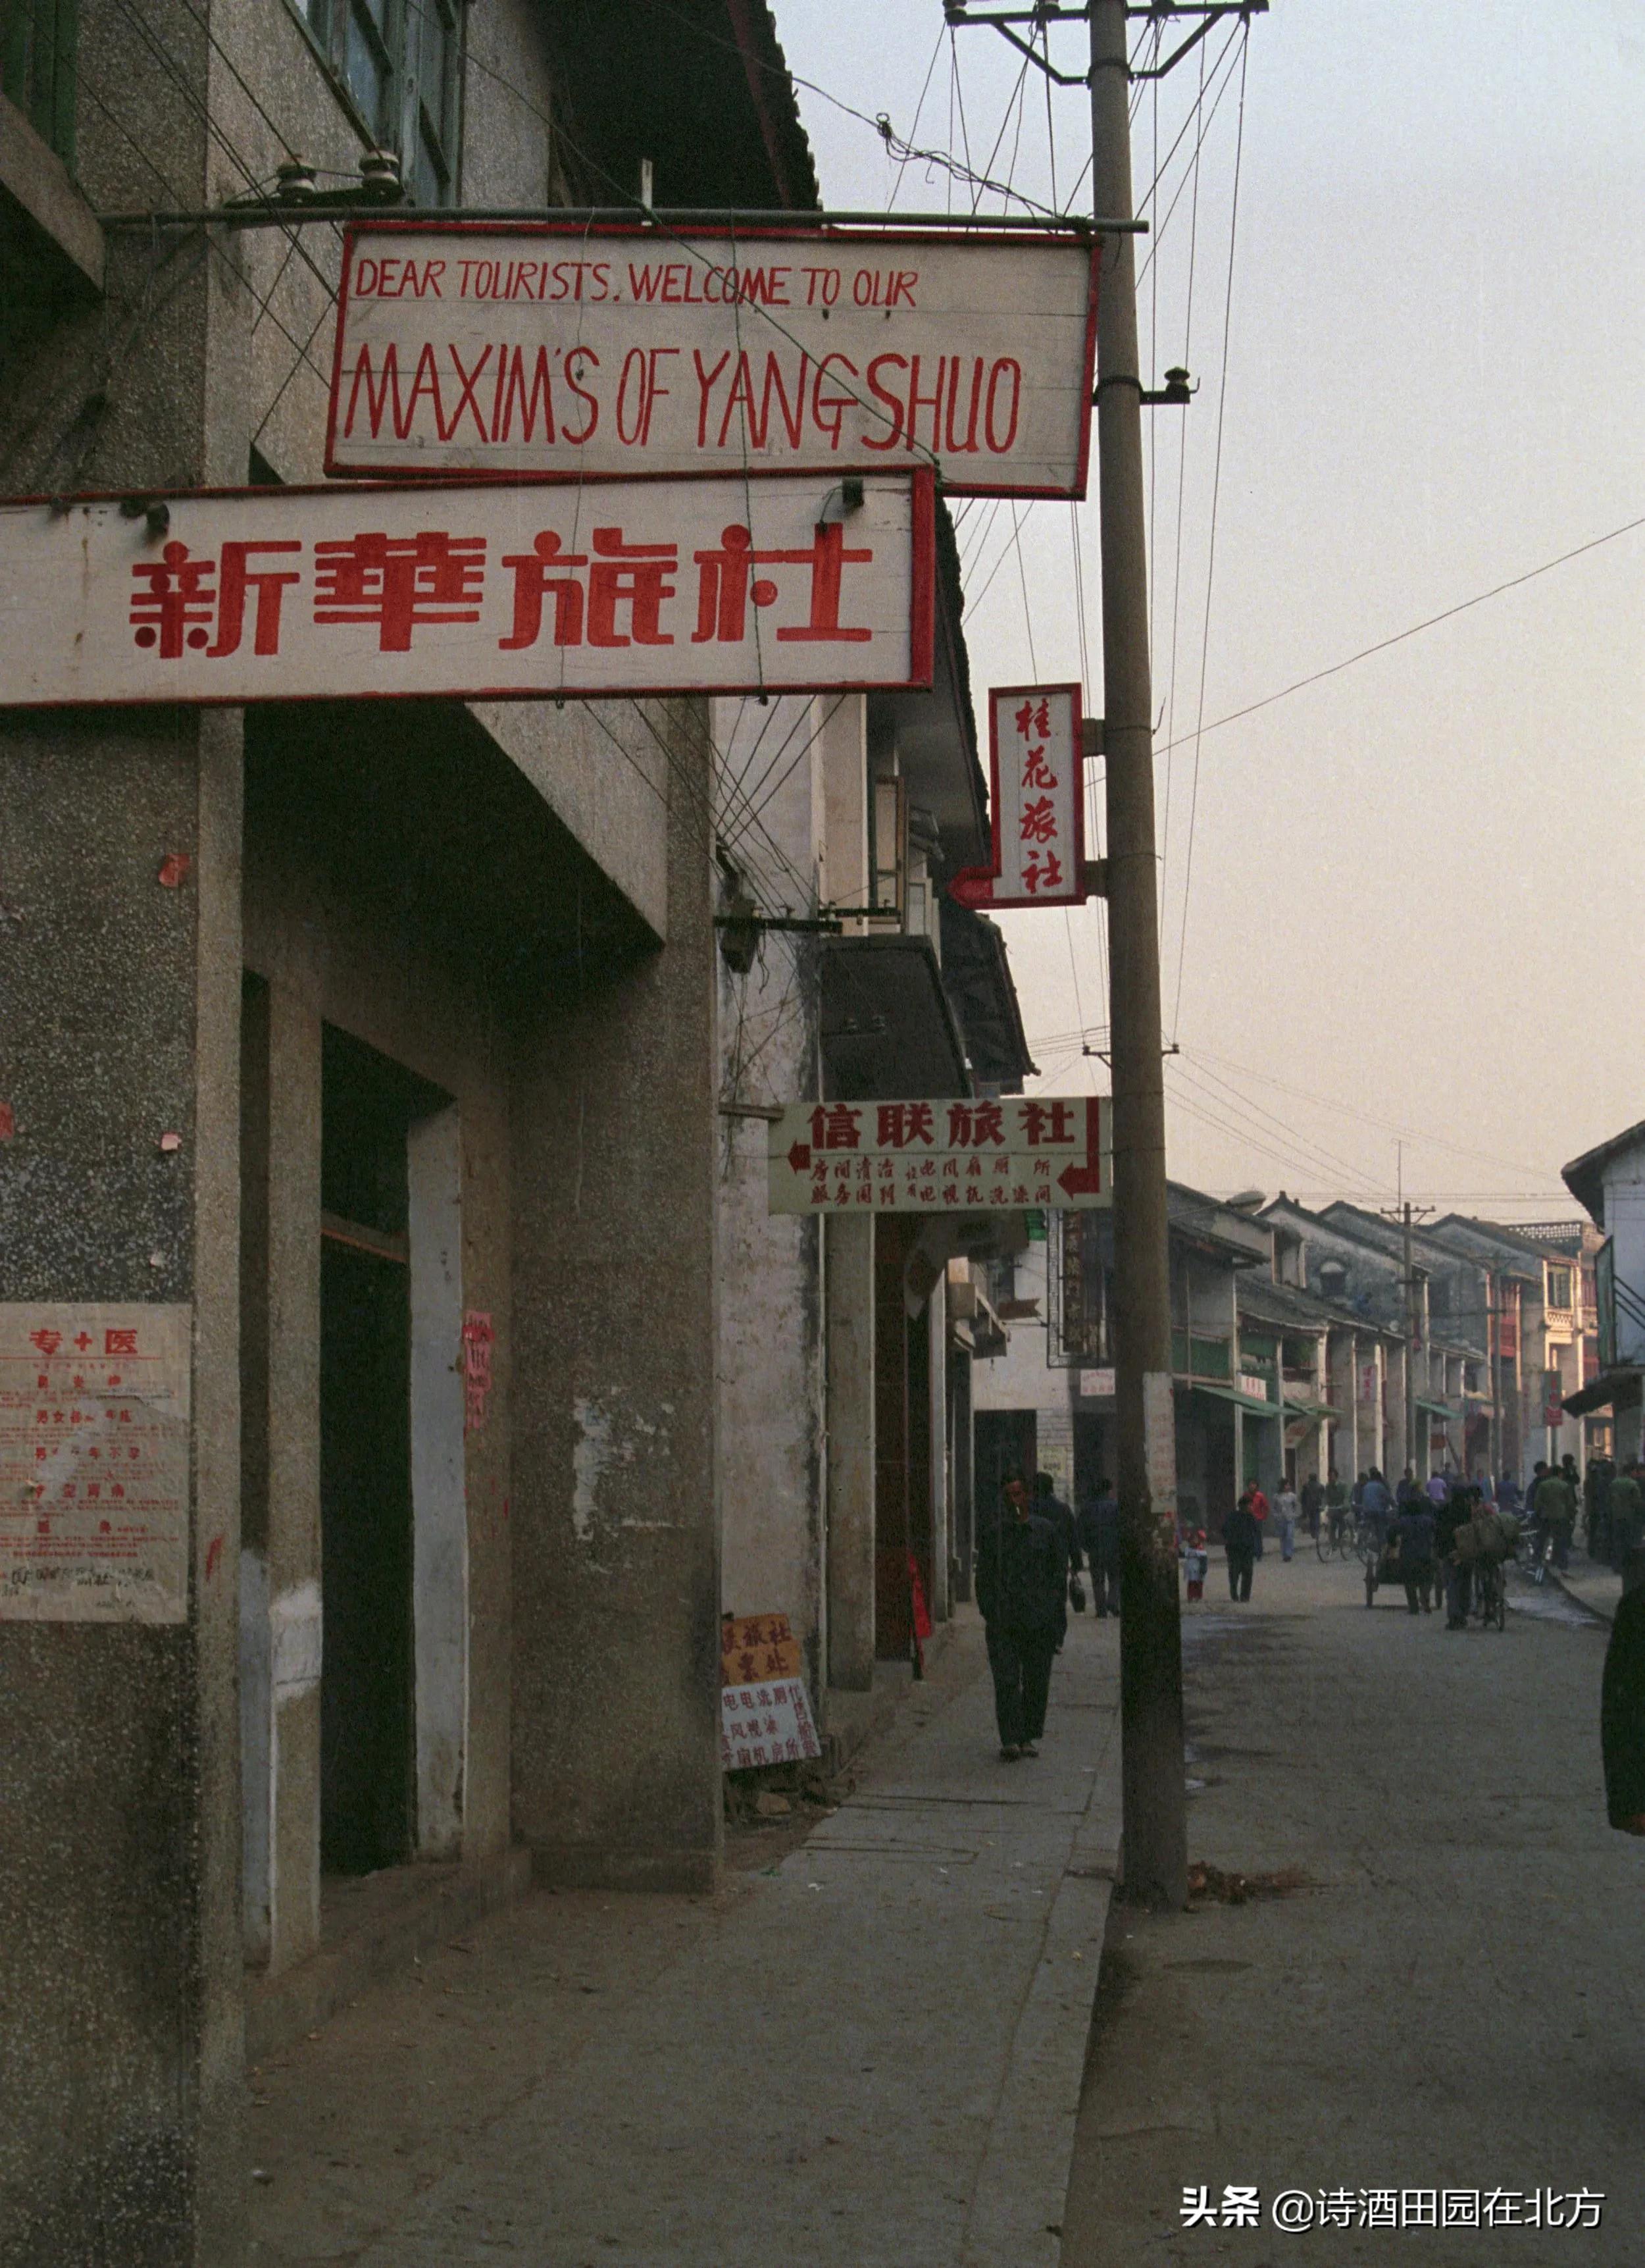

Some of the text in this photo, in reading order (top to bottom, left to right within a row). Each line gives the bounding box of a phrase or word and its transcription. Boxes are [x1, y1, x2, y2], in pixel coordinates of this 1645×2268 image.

[355, 259, 447, 298] DEAR
[629, 263, 790, 307] WELCOME
[799, 266, 840, 307] TO
[853, 269, 918, 308] OUR
[343, 342, 1021, 454] MAXIM'S OF YANGSHUO
[1015, 698, 1063, 894] 桂花旅社
[807, 1100, 1075, 1150] 信联旅社
